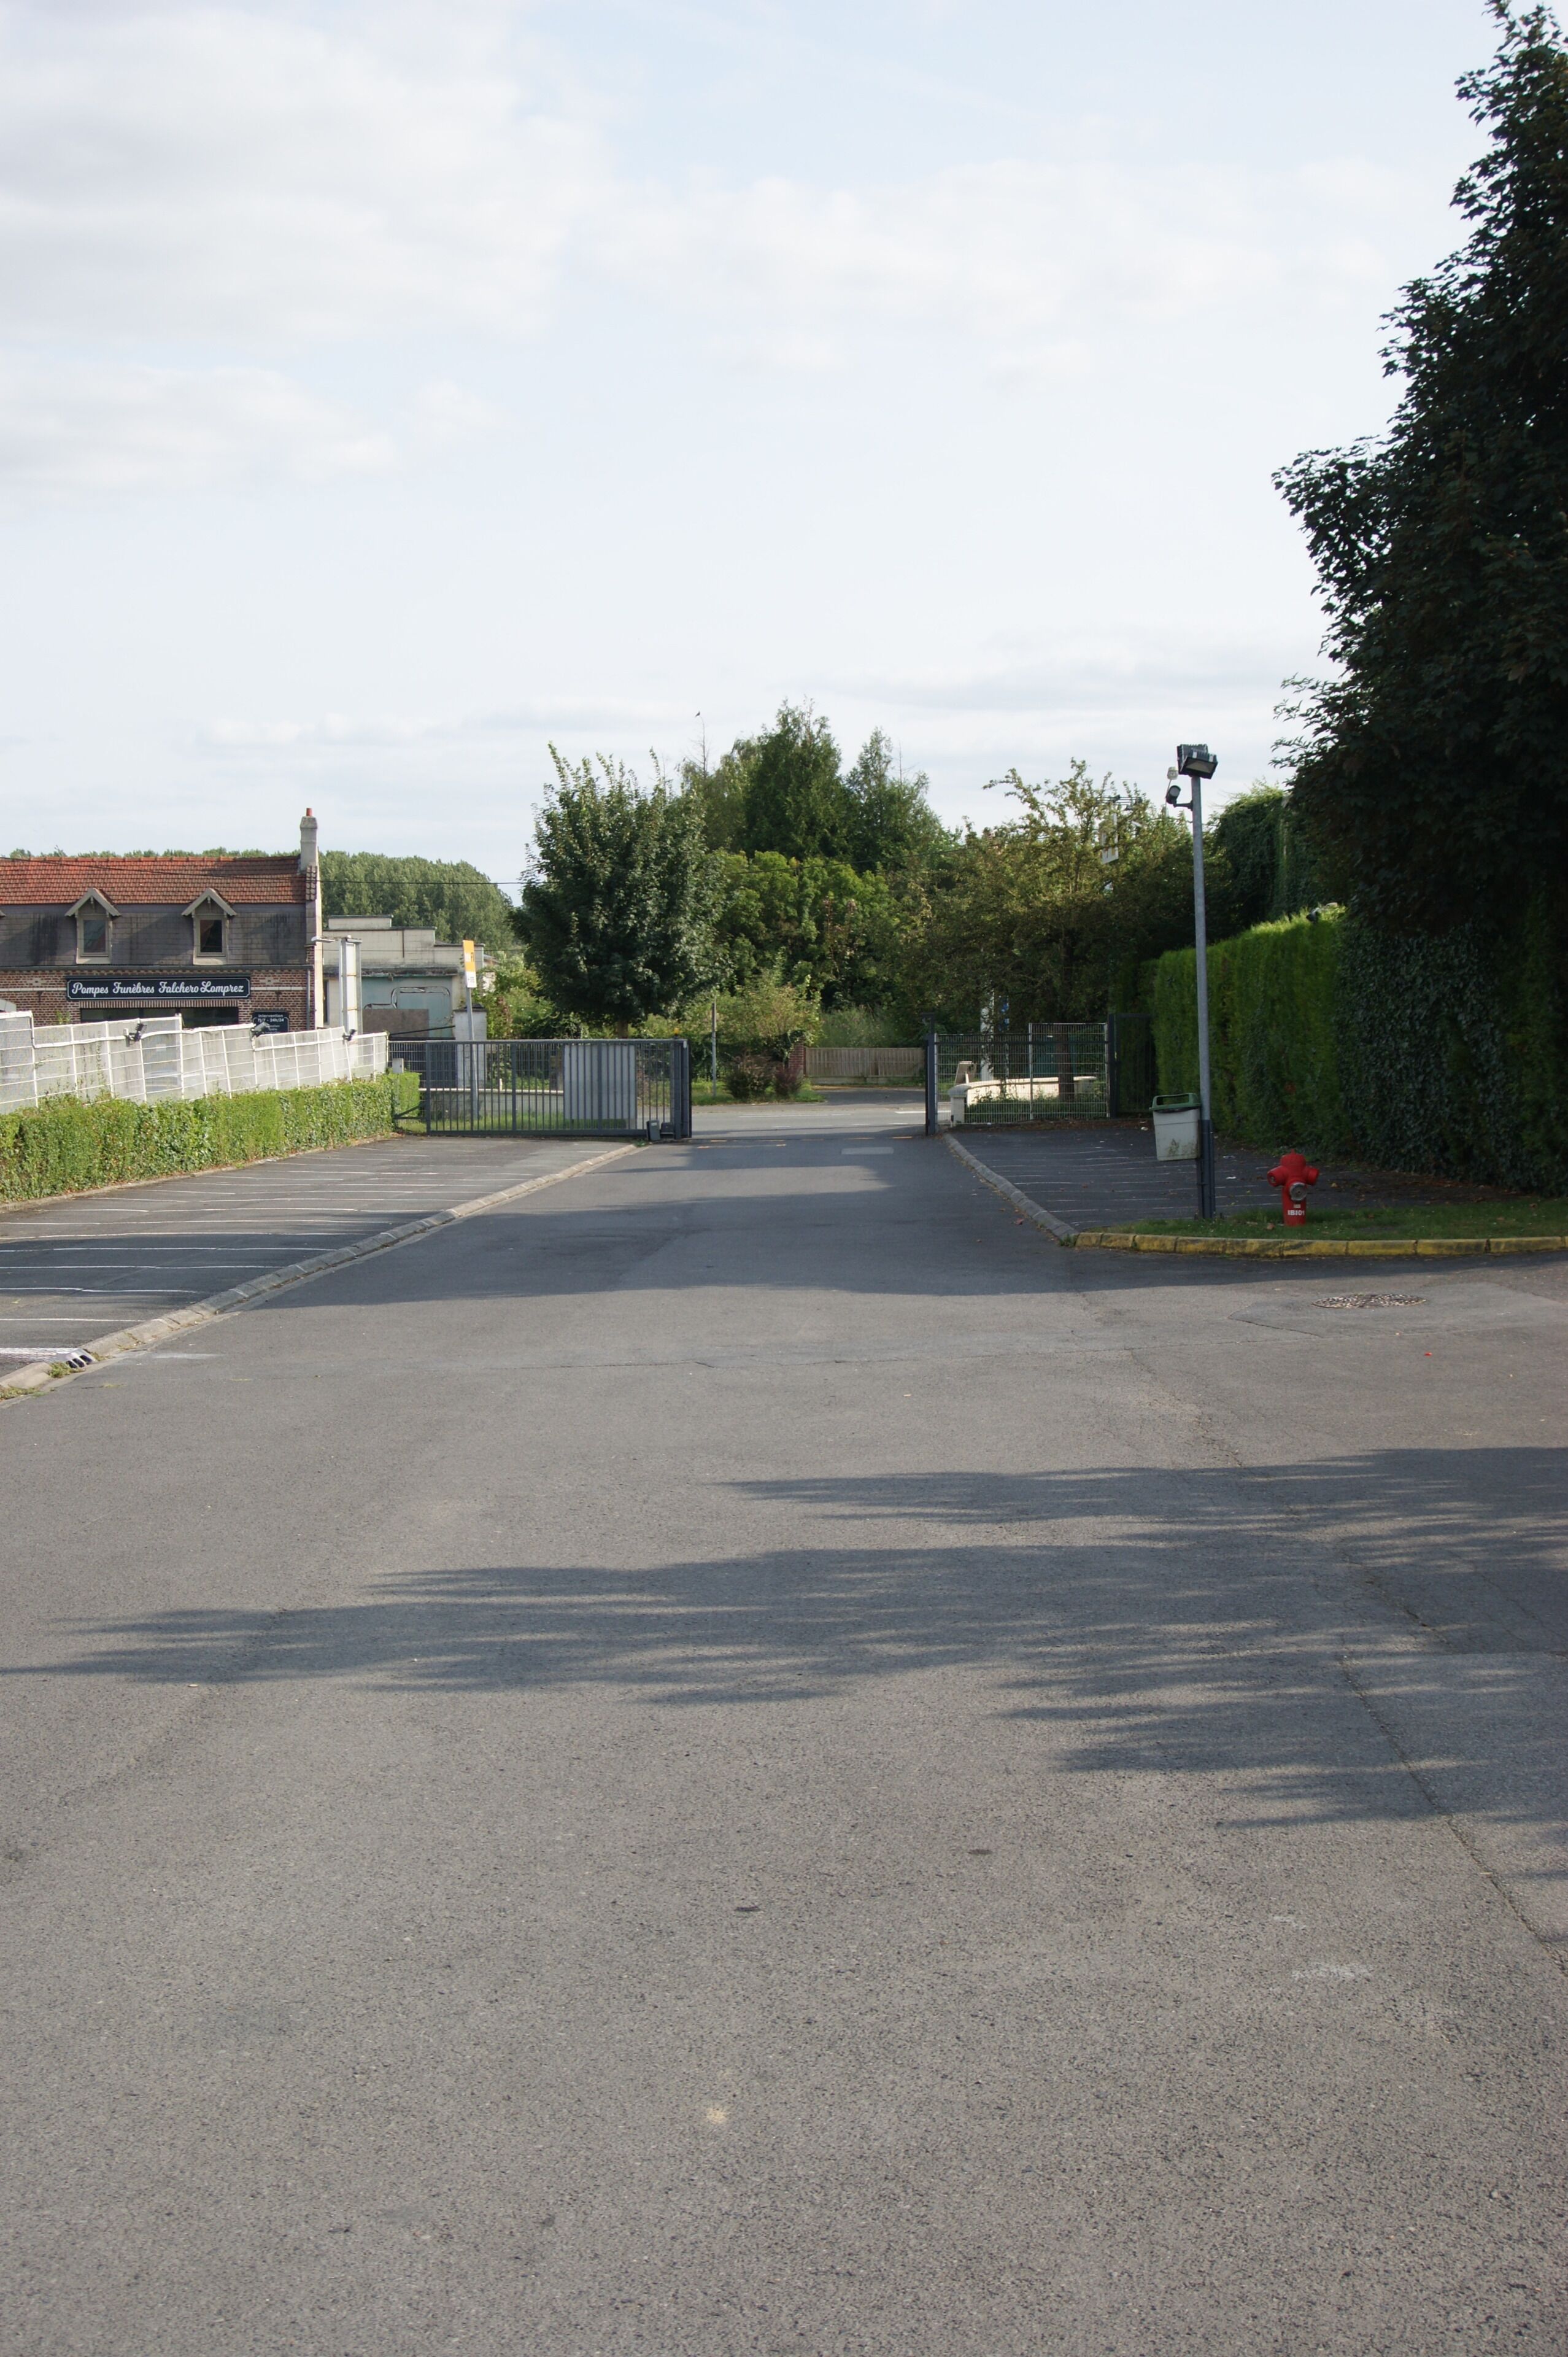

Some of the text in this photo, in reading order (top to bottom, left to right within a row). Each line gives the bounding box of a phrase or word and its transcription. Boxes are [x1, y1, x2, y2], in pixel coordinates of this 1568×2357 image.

[71, 981, 244, 997] Pompes Funèbres Falchero Lomprez
